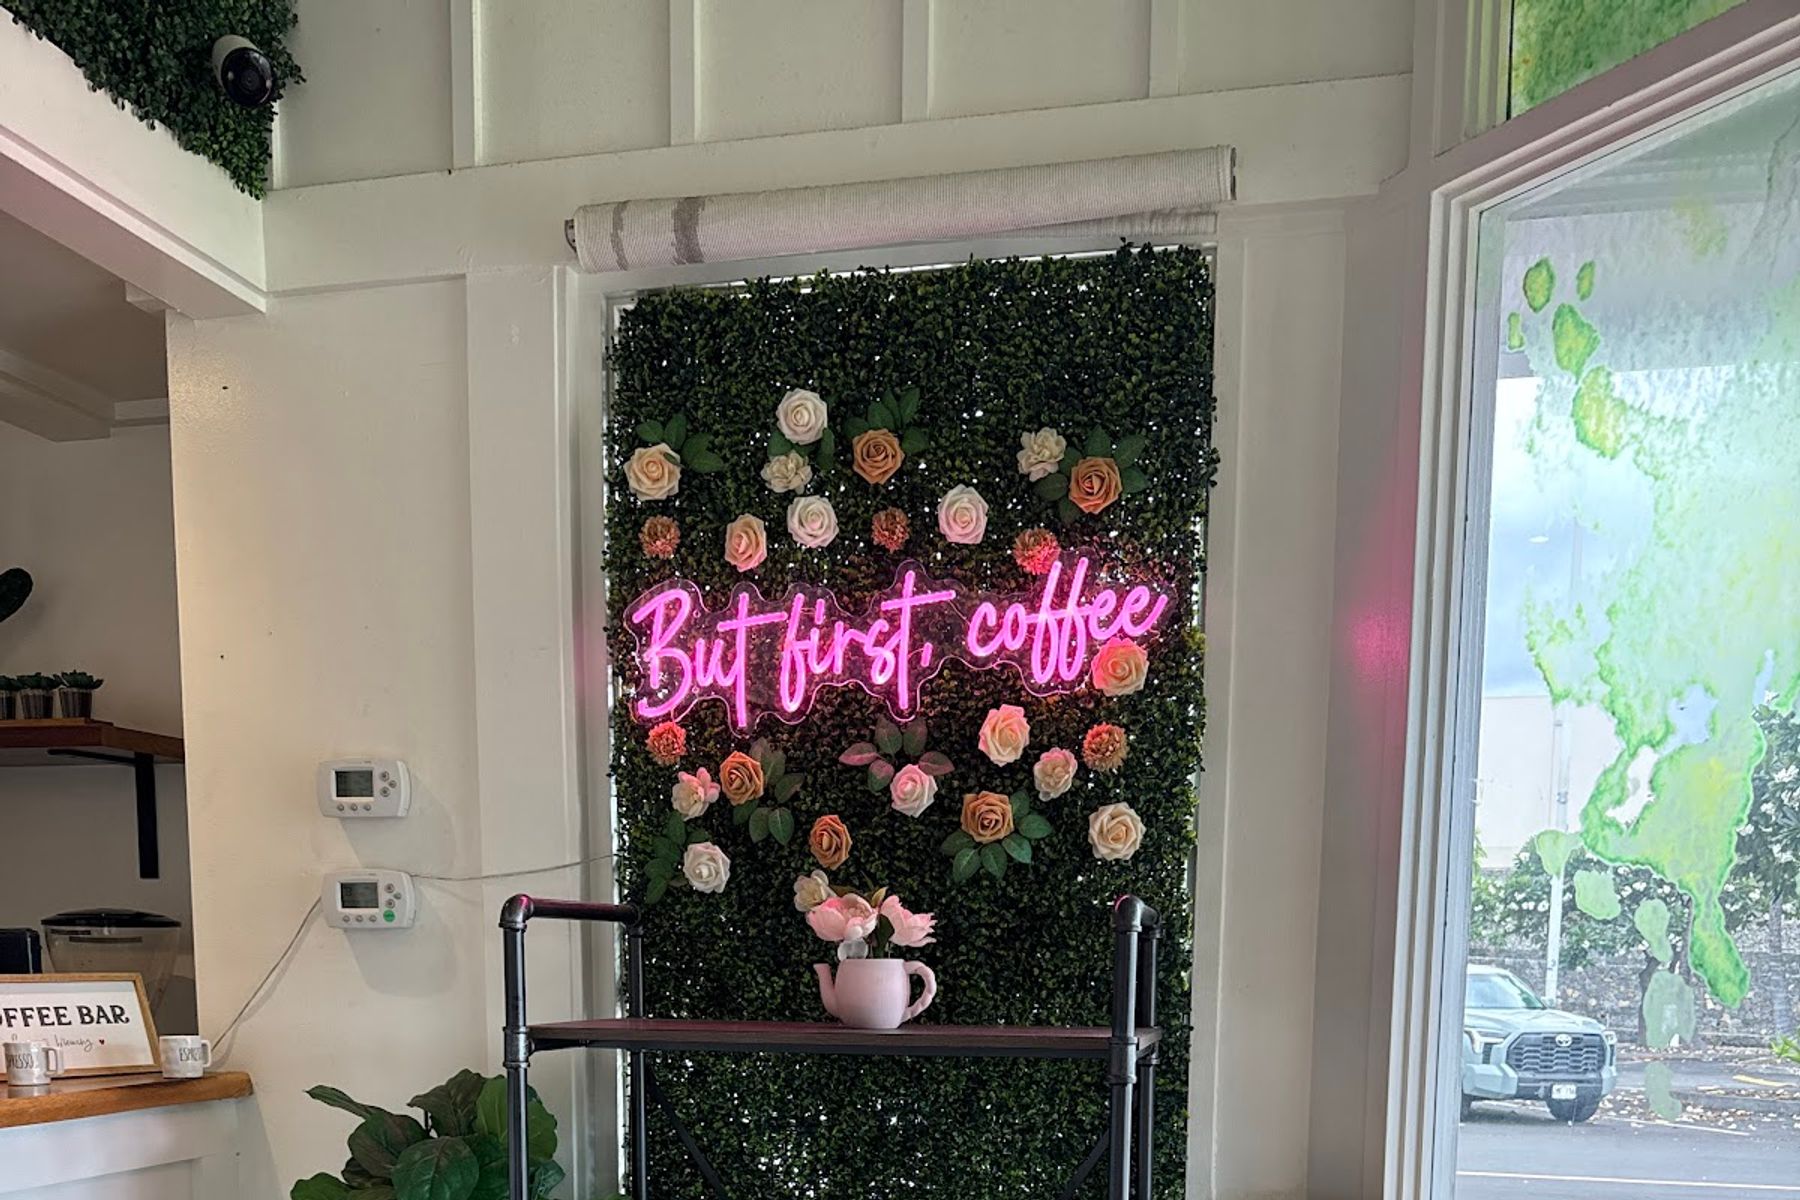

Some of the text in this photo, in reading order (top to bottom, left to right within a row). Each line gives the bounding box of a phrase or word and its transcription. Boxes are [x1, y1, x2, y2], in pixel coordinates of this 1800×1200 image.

[632, 556, 1169, 728] But first, coffee
[0, 1005, 130, 1028] FFEE BAR
